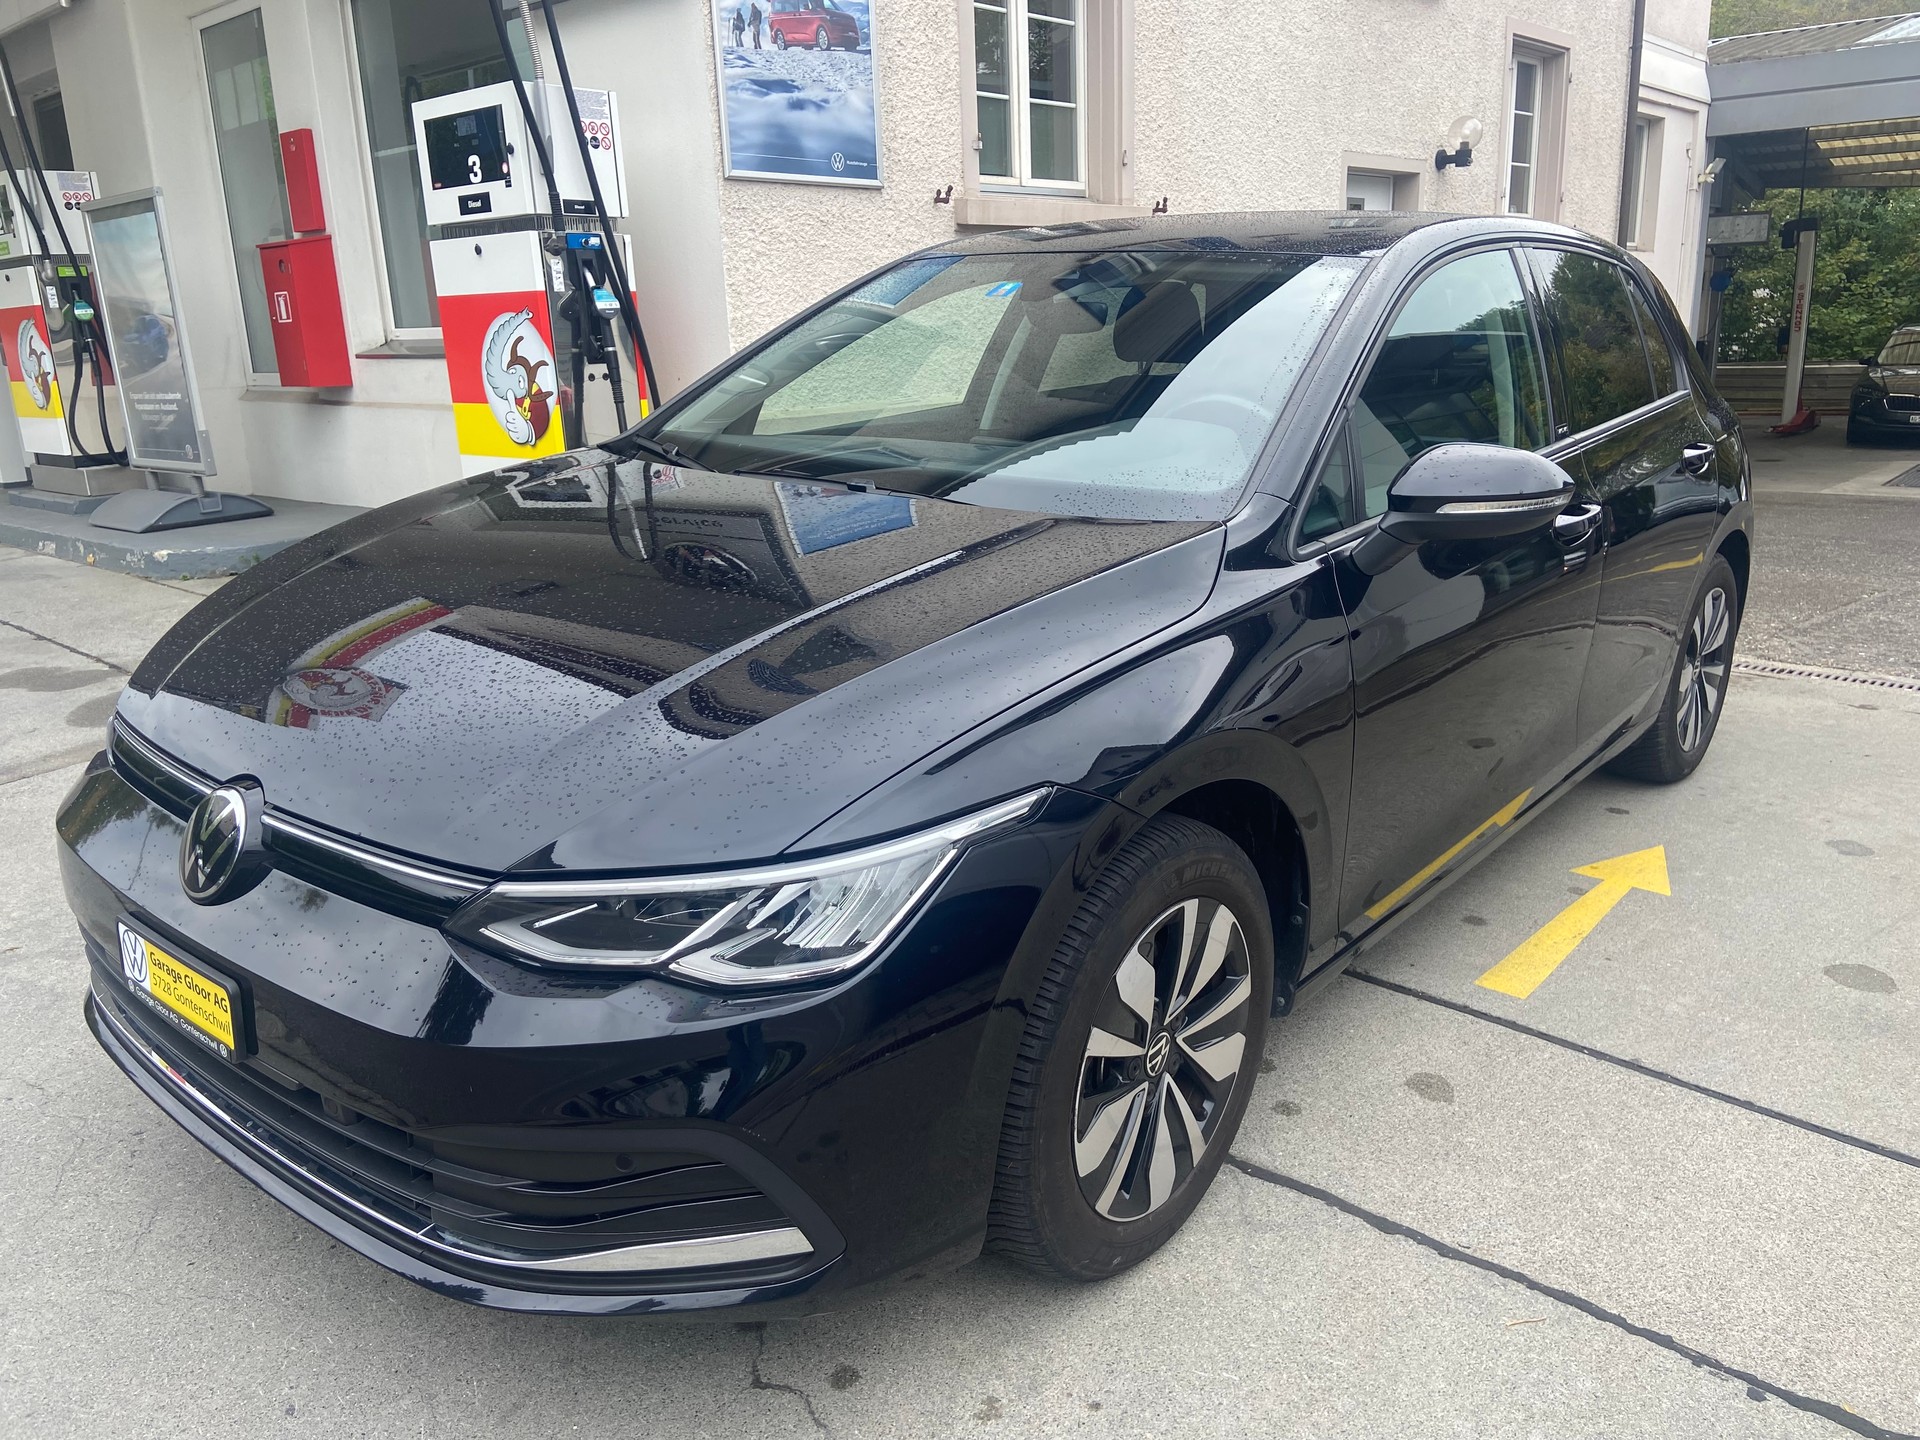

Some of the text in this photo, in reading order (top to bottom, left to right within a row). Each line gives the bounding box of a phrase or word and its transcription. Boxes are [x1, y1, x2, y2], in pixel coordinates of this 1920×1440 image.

[467, 154, 482, 183] 3
[467, 199, 482, 208] Diesel
[150, 952, 229, 1014] Garage Gloor AG
[152, 972, 232, 1037] 5728 Gontenschwil
[135, 986, 155, 1007] Garage
[169, 1011, 179, 1023] AG
[180, 1018, 218, 1050] Gontenschwil
